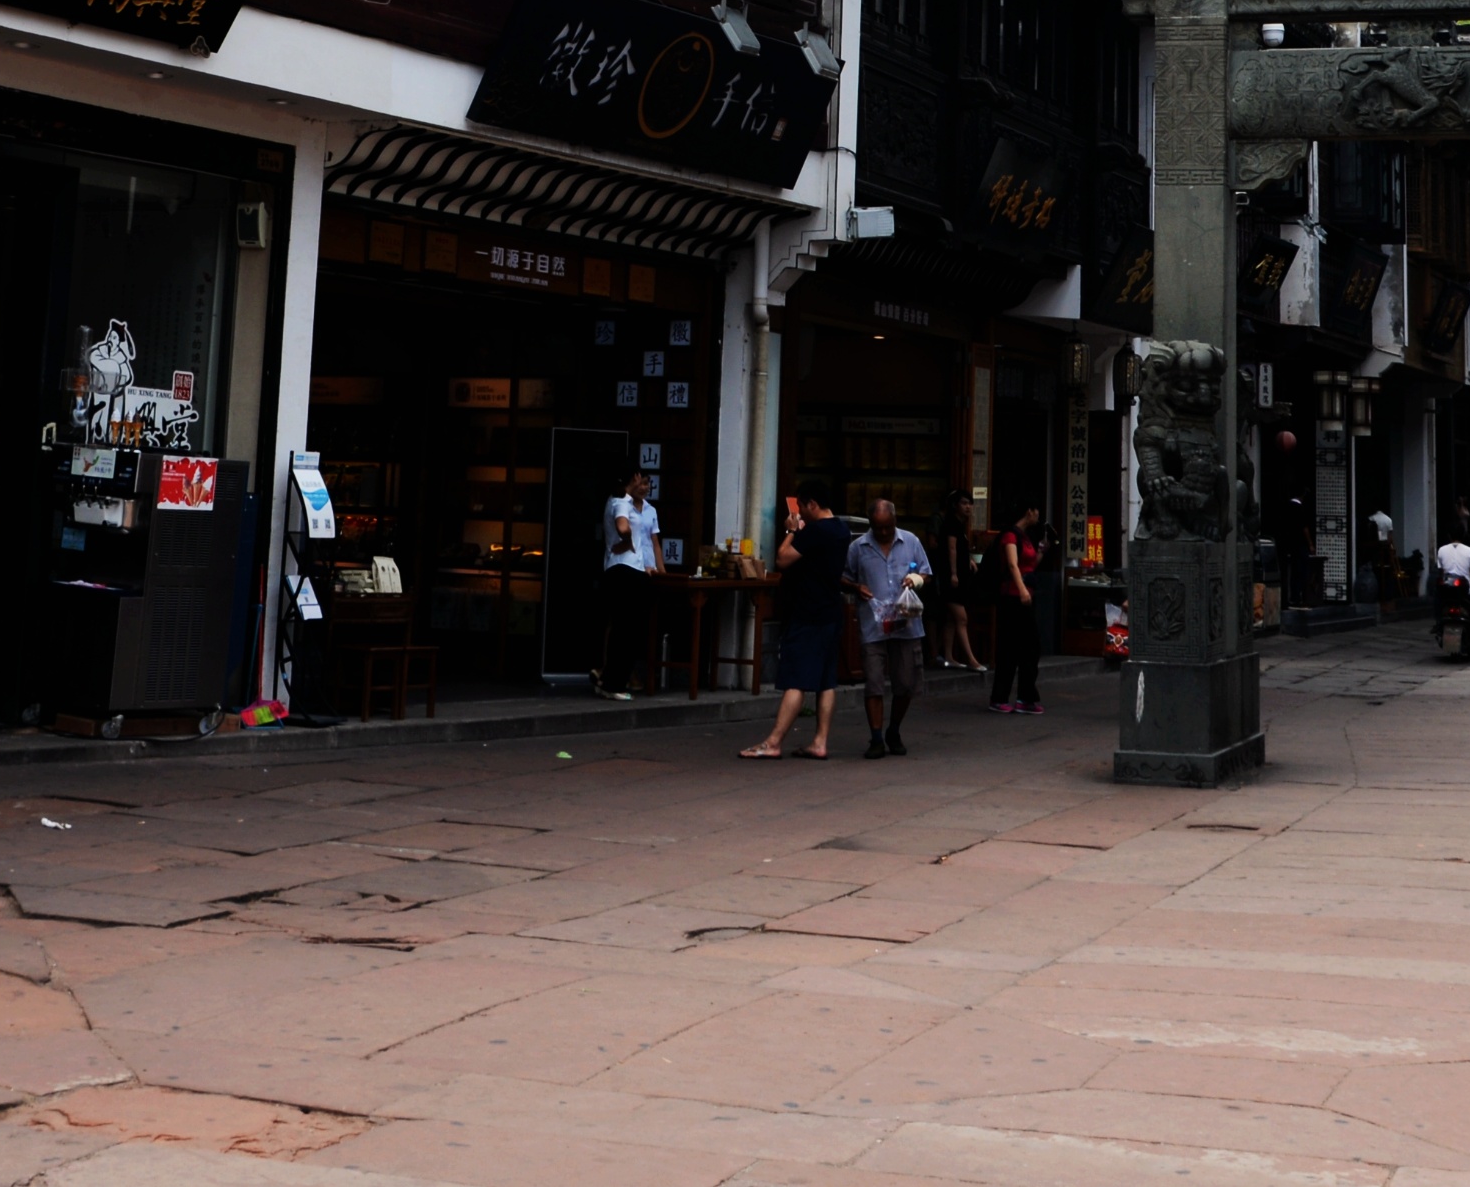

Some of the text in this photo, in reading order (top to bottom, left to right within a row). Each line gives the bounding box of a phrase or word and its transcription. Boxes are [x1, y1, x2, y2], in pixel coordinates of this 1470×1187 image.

[645, 354, 662, 374] 手
[155, 391, 172, 399] TANG
[174, 389, 190, 400] 1823
[619, 384, 635, 404] 信
[643, 447, 657, 464] 山
